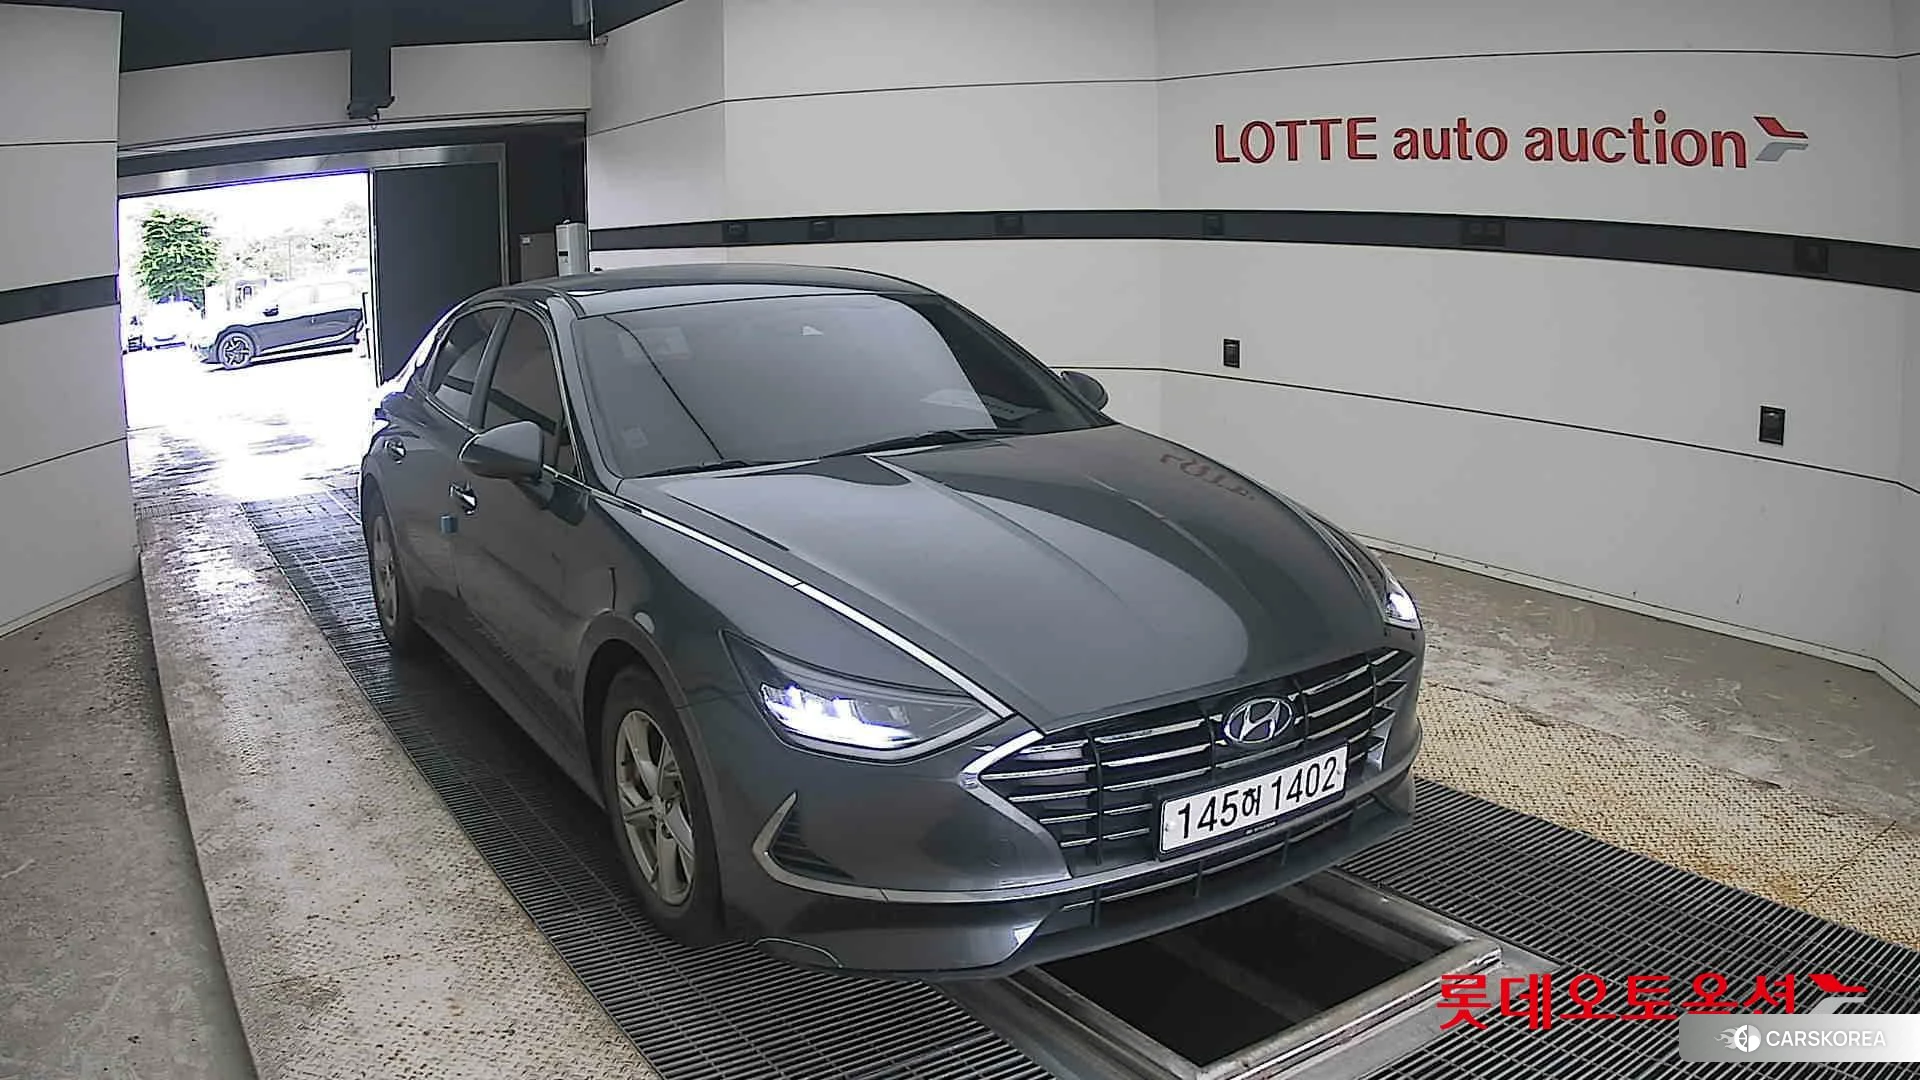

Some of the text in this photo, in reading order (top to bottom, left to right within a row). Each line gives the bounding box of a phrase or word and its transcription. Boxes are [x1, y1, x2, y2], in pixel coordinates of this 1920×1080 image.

[1214, 109, 1748, 169] LOTTE auto auction
[1177, 756, 1338, 839] 145허 1402
